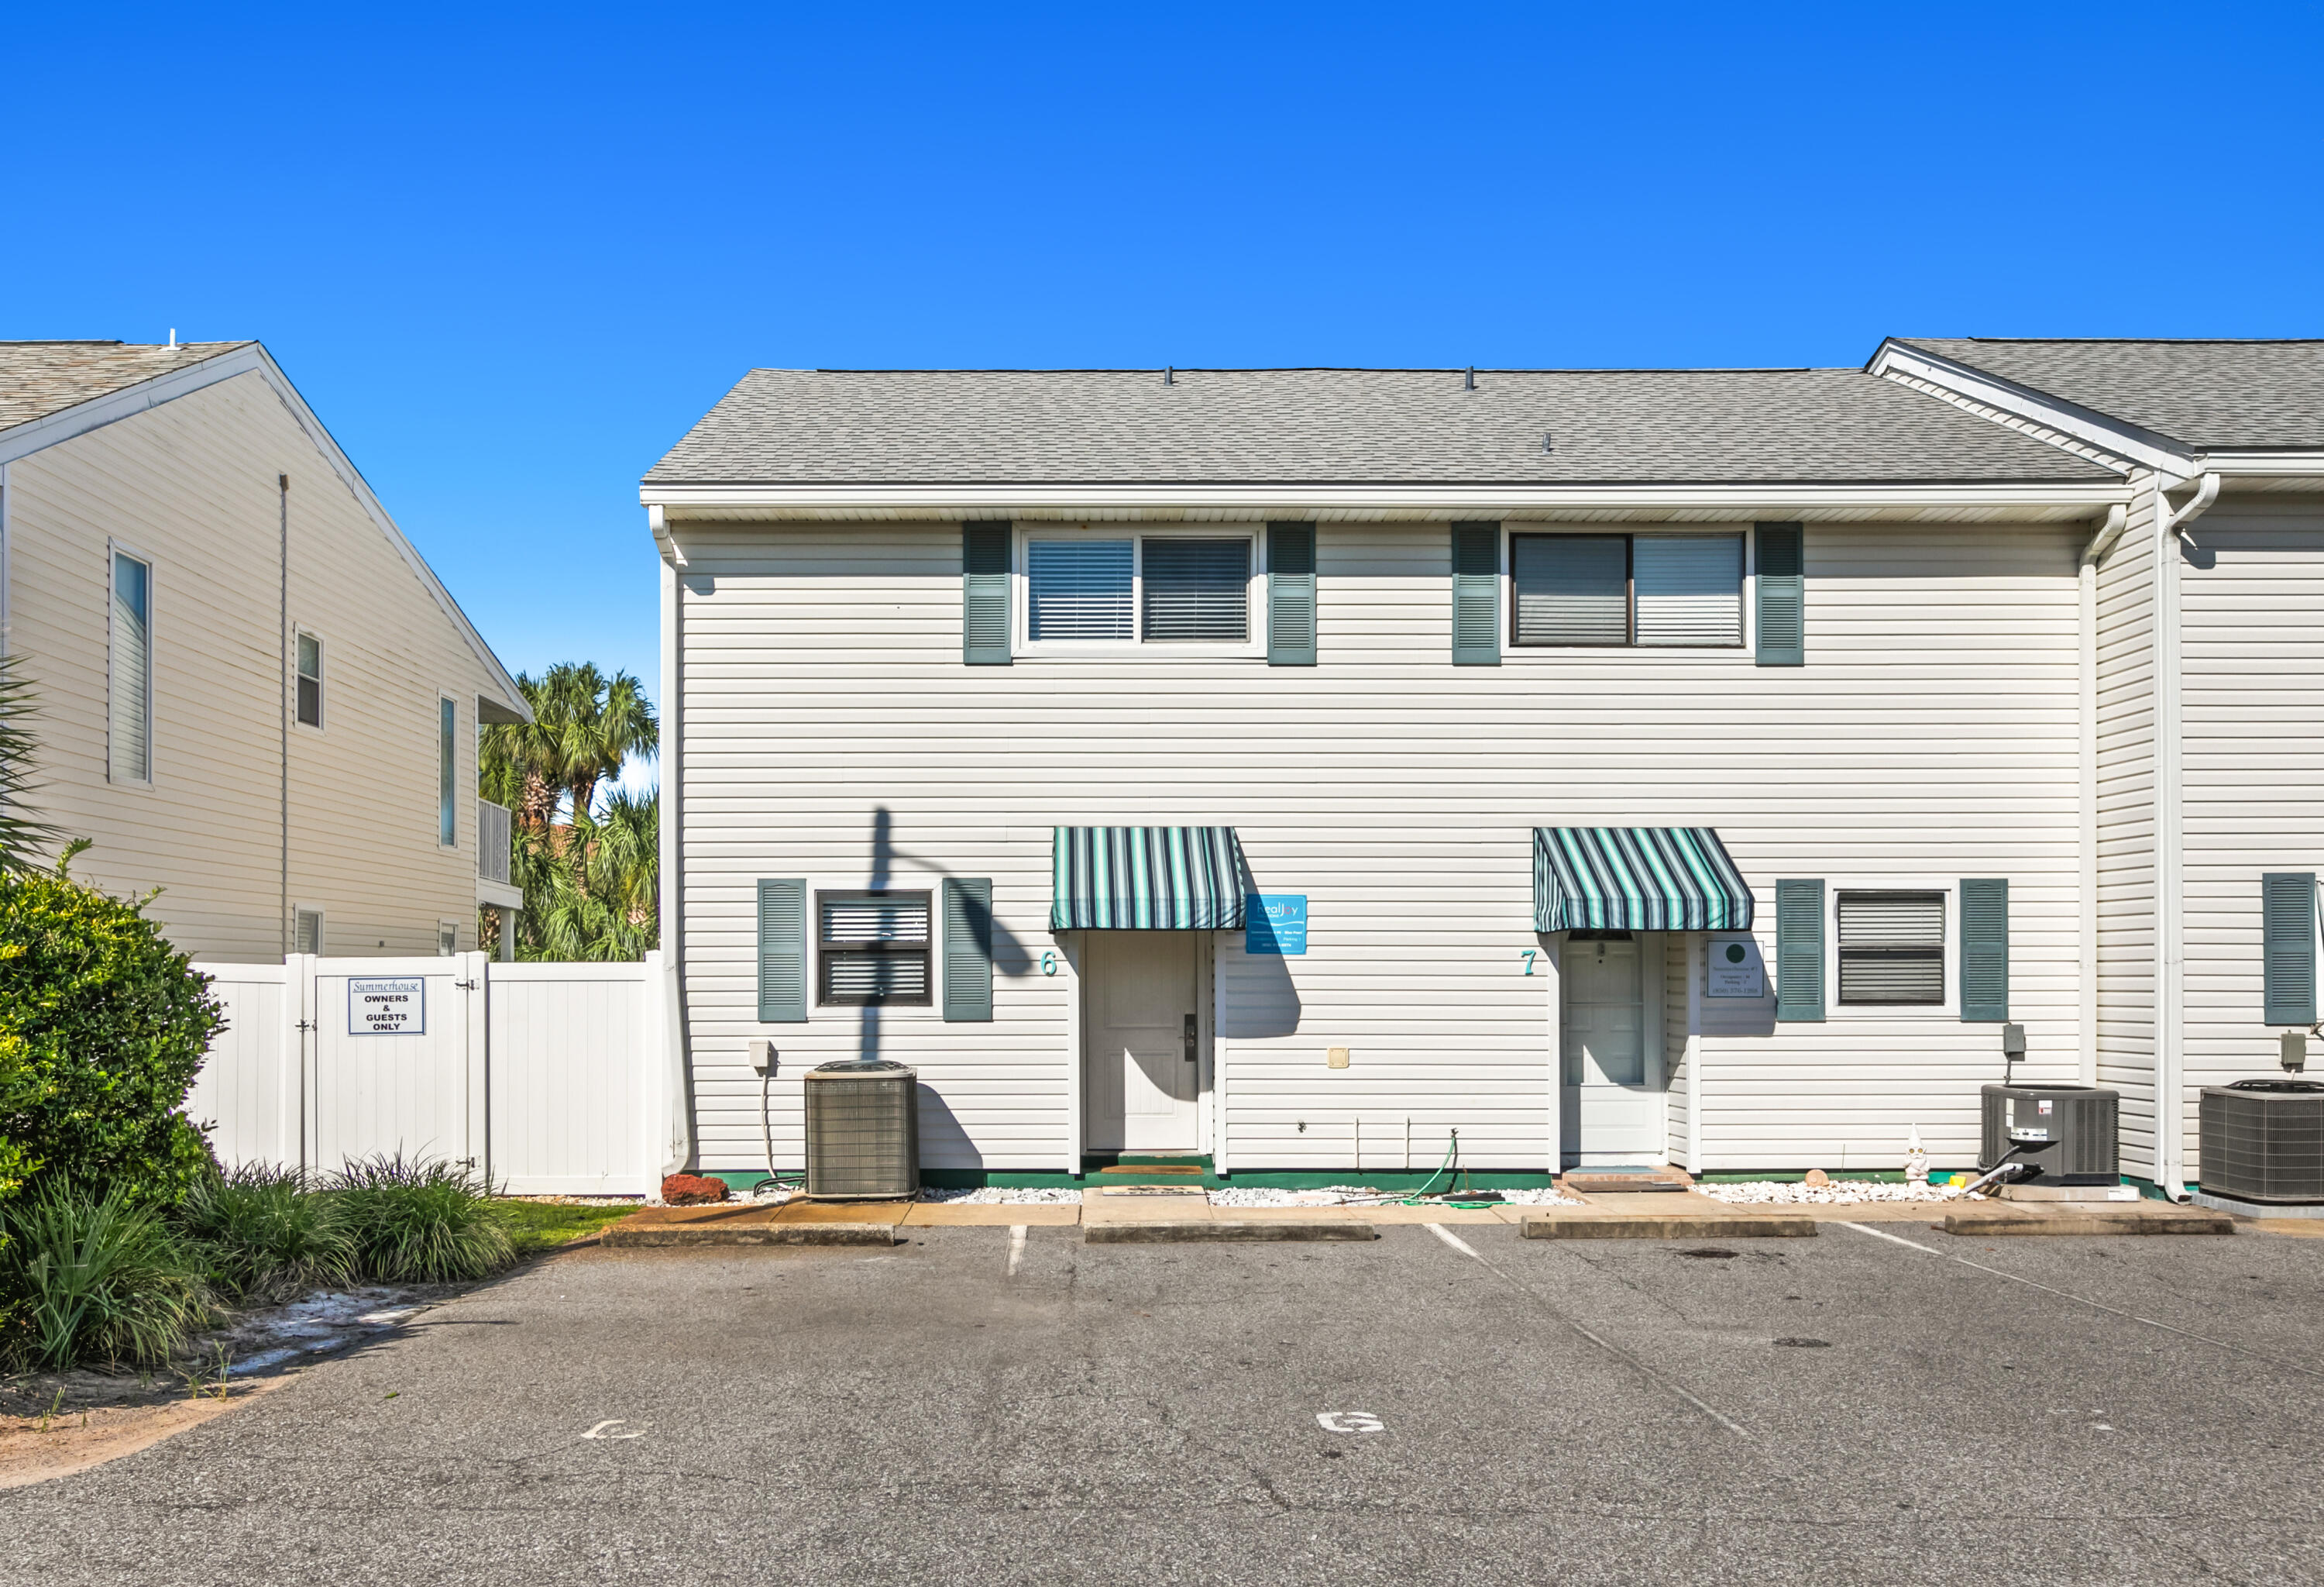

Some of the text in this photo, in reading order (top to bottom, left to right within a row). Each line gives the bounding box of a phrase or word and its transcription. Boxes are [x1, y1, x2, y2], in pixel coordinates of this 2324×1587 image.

[1257, 901, 1298, 917] RealJoy
[1040, 950, 1057, 977] 6
[1521, 949, 1537, 976] 7
[353, 979, 418, 992] Summerhouse
